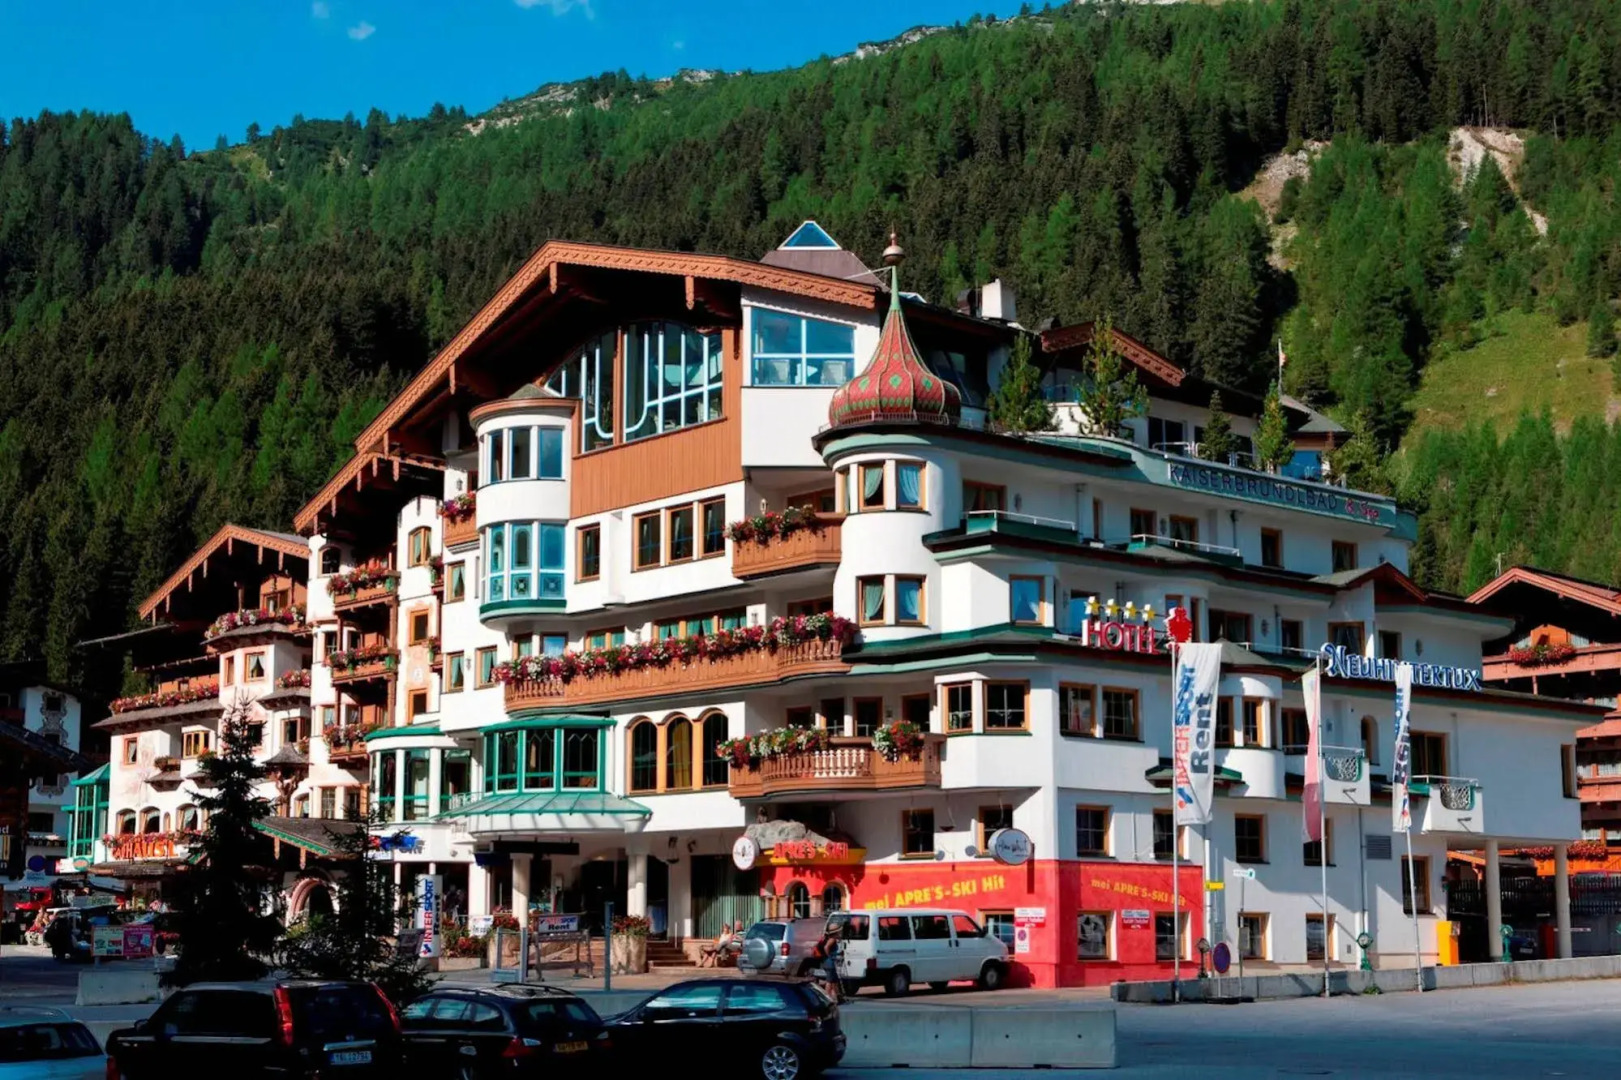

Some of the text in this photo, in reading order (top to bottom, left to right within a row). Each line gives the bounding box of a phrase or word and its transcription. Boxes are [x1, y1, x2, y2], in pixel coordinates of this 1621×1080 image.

[1083, 619, 1159, 655] HOTEL
[1175, 663, 1196, 787] INTERSPORT
[1190, 692, 1213, 774] Rent
[981, 874, 1005, 892] Hit
[1091, 879, 1111, 890] mei
[423, 879, 434, 943] INTERSPORT
